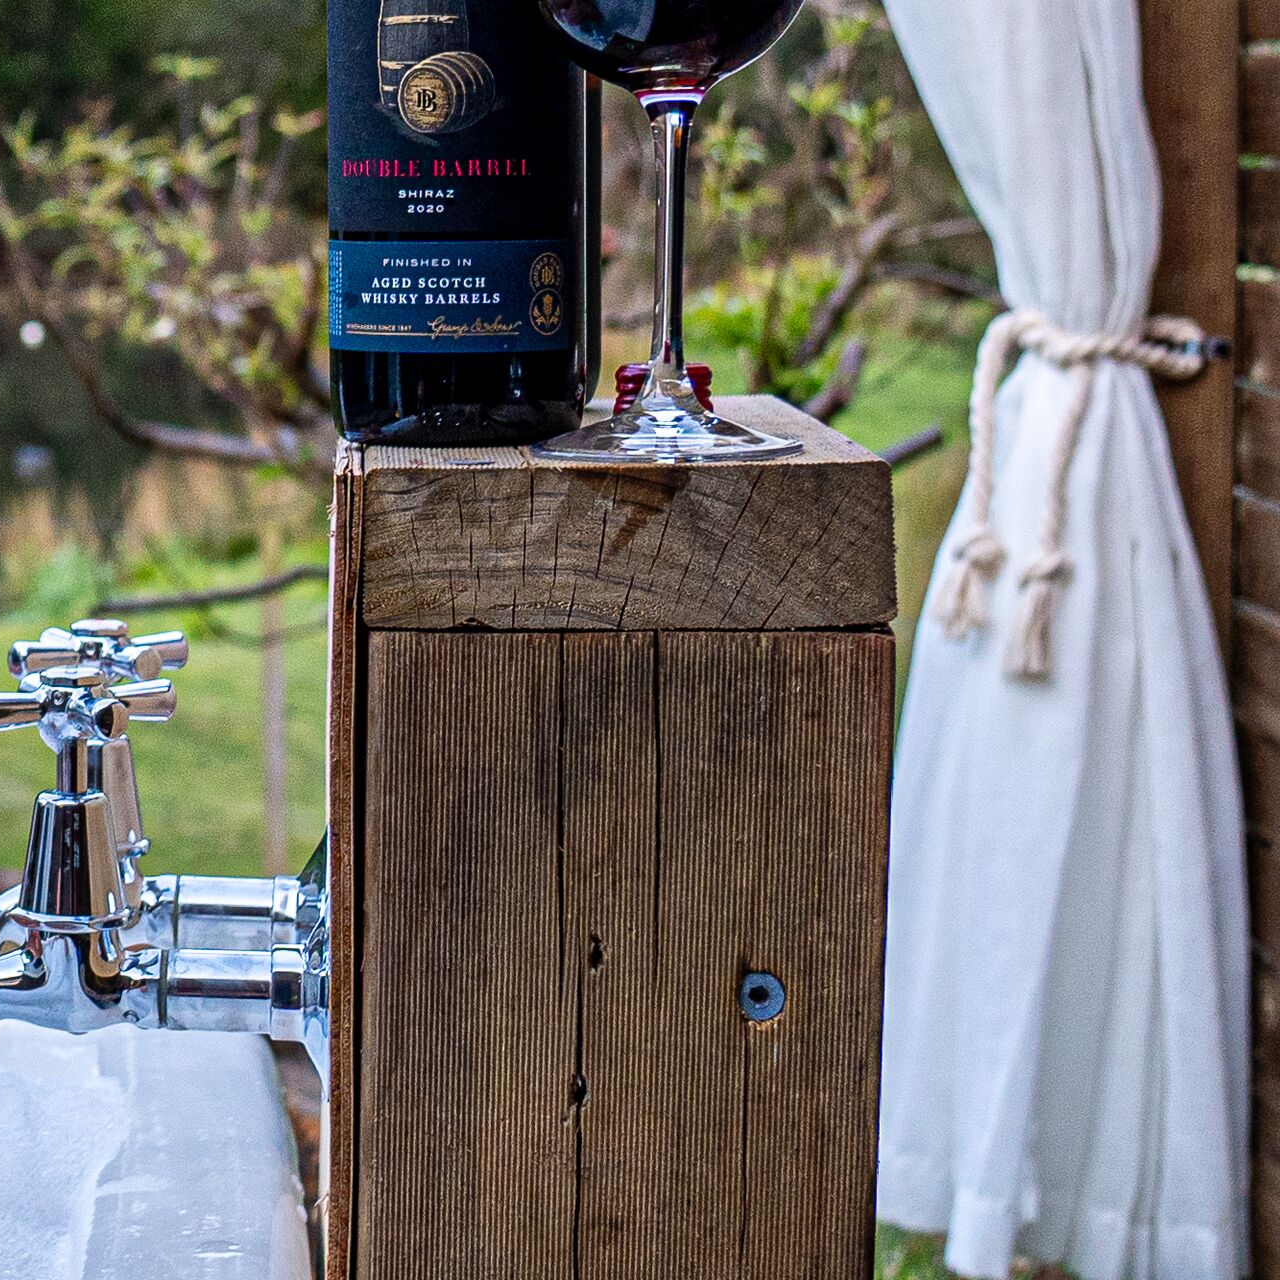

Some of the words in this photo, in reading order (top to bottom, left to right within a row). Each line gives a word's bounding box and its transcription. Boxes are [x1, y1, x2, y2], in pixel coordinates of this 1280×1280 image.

[342, 159, 421, 177] DOUBLE
[433, 159, 532, 177] BARREL
[398, 189, 455, 199] SHIRAZ
[407, 204, 445, 214] 2020
[382, 258, 451, 267] FINISHED
[457, 258, 472, 267] IN
[371, 277, 412, 289] AGED
[418, 277, 486, 289] SCOTCH
[361, 293, 419, 305] WHISKY
[425, 292, 501, 305] BARRELS
